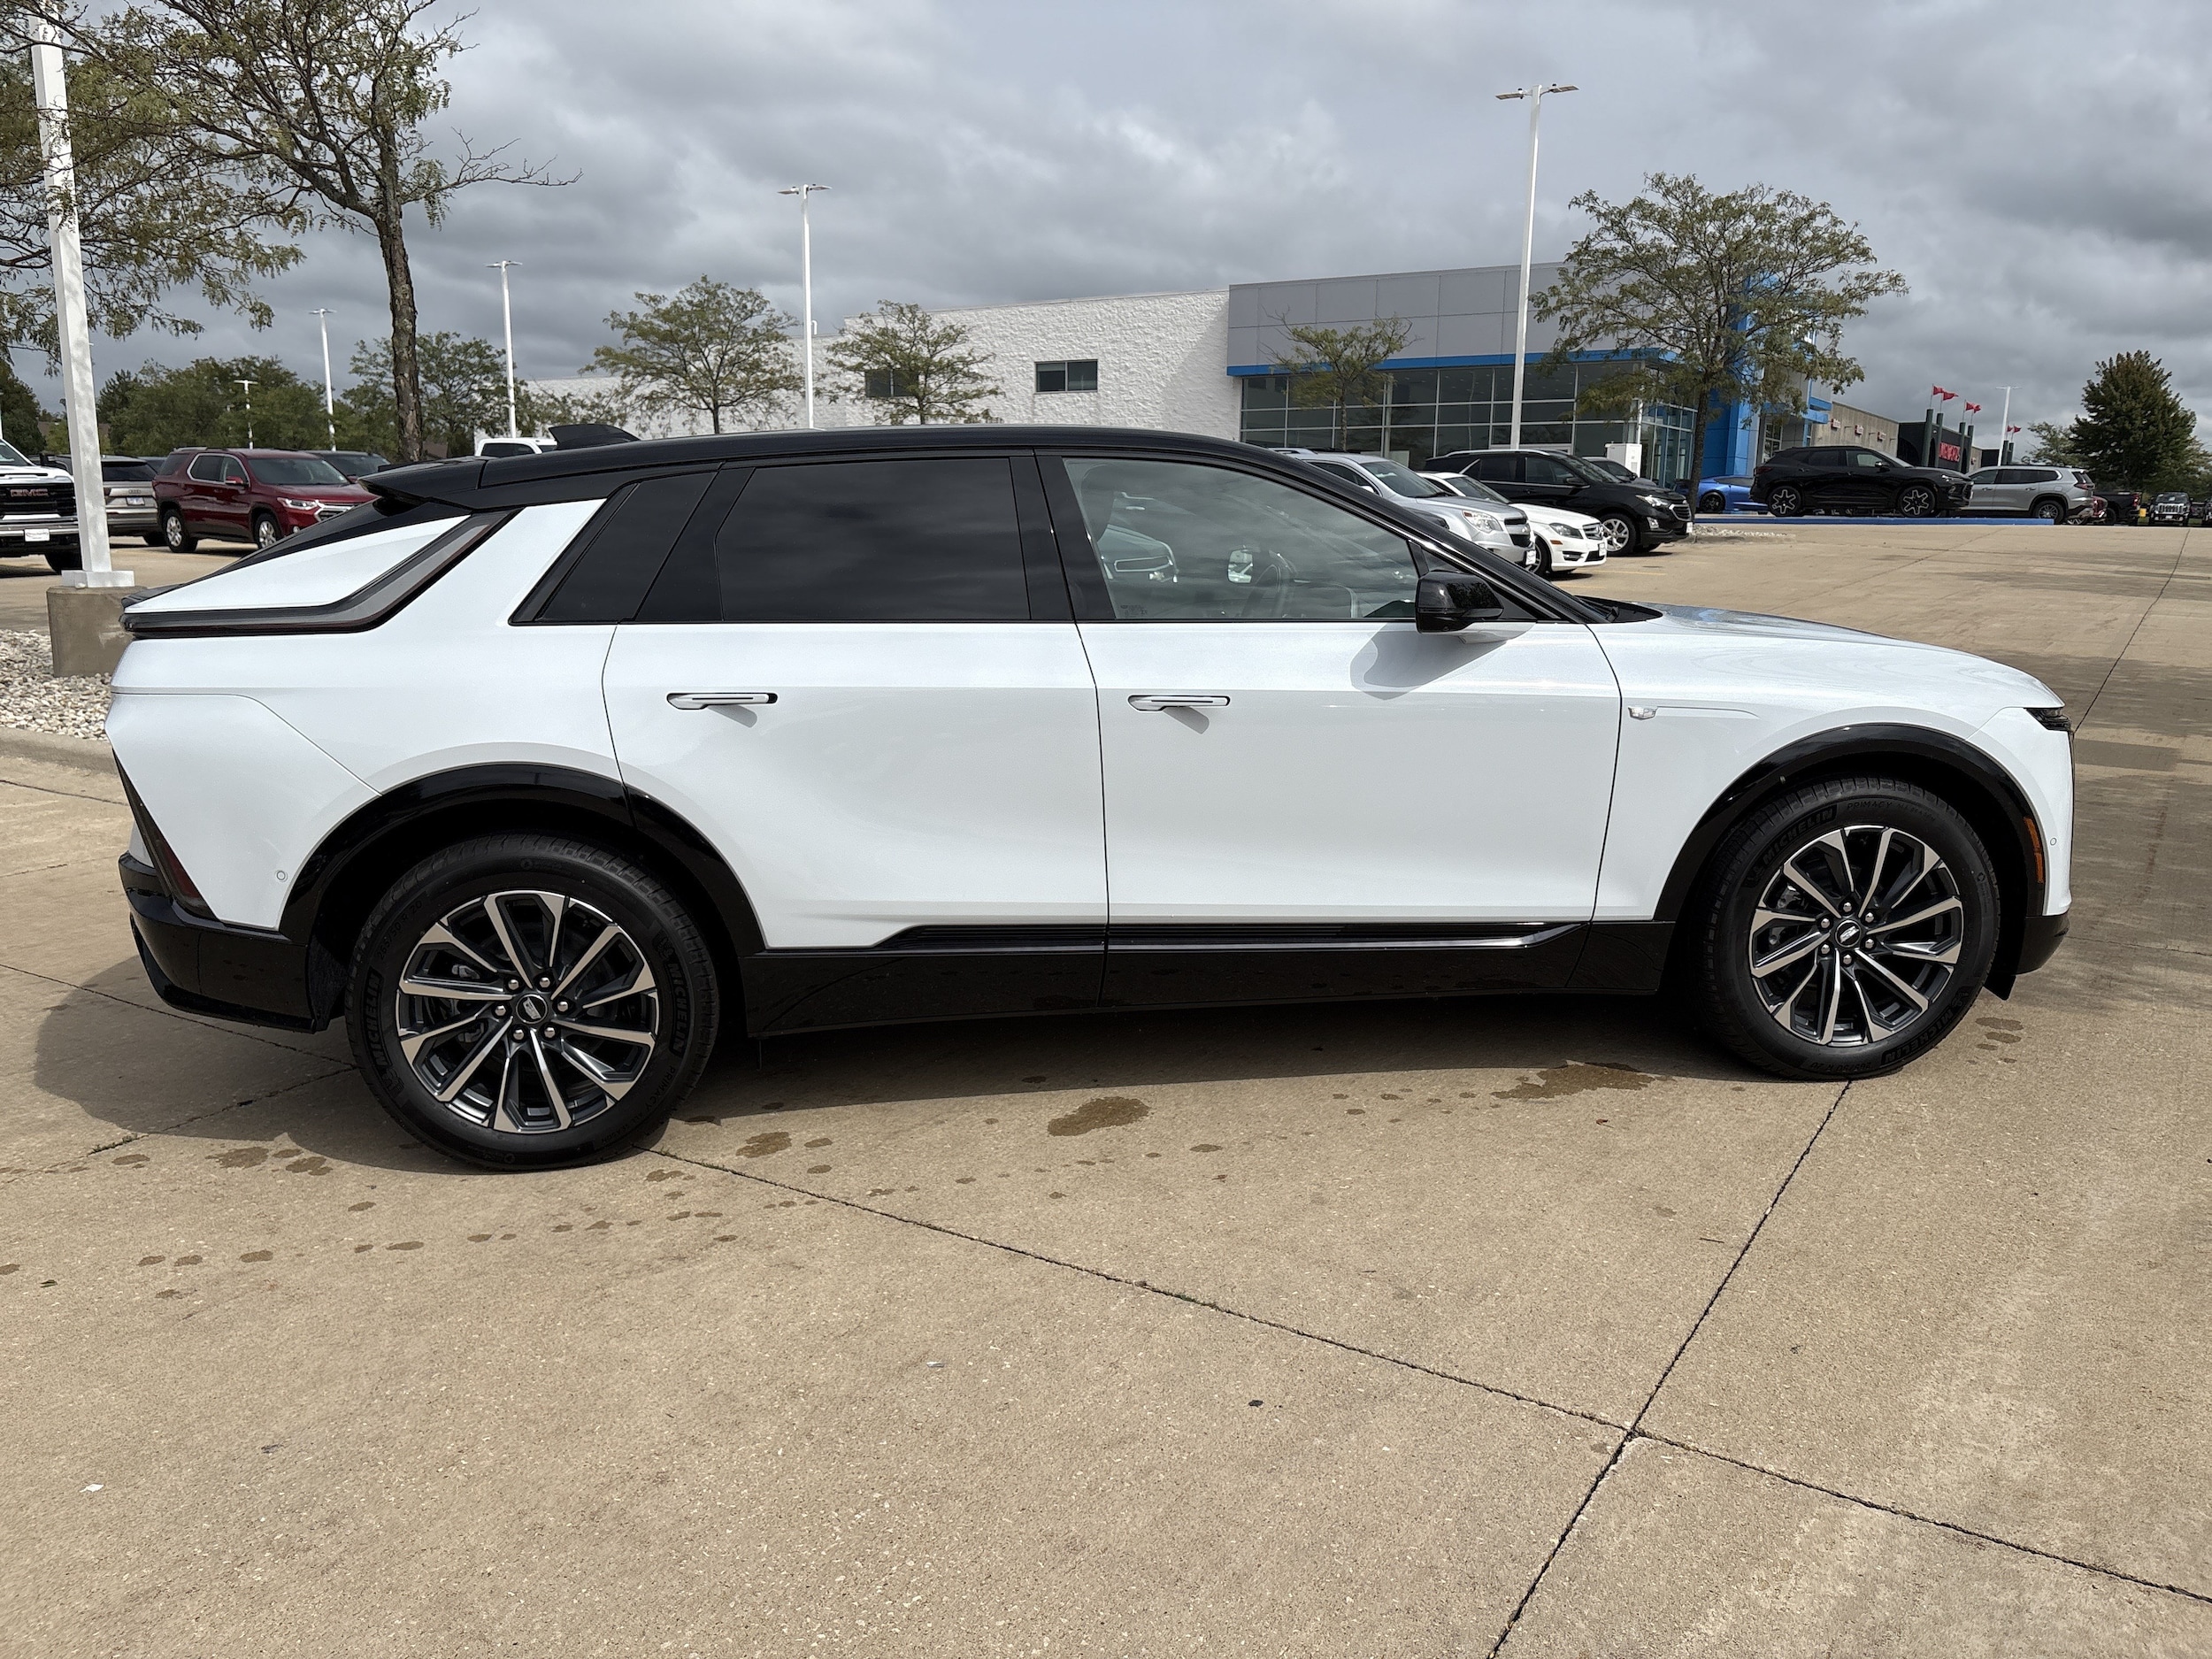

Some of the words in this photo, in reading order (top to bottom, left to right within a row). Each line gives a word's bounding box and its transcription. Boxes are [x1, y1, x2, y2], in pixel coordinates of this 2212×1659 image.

[11, 488, 49, 497] GMC
[1847, 800, 1893, 810] PRIMACY
[1763, 808, 1832, 865] MICHELIN
[365, 973, 388, 1065] MICHELIN
[668, 964, 687, 1053] MICHELIN
[1885, 1010, 1953, 1064] MICHELIN
[644, 1066, 676, 1111] PRIMACY
